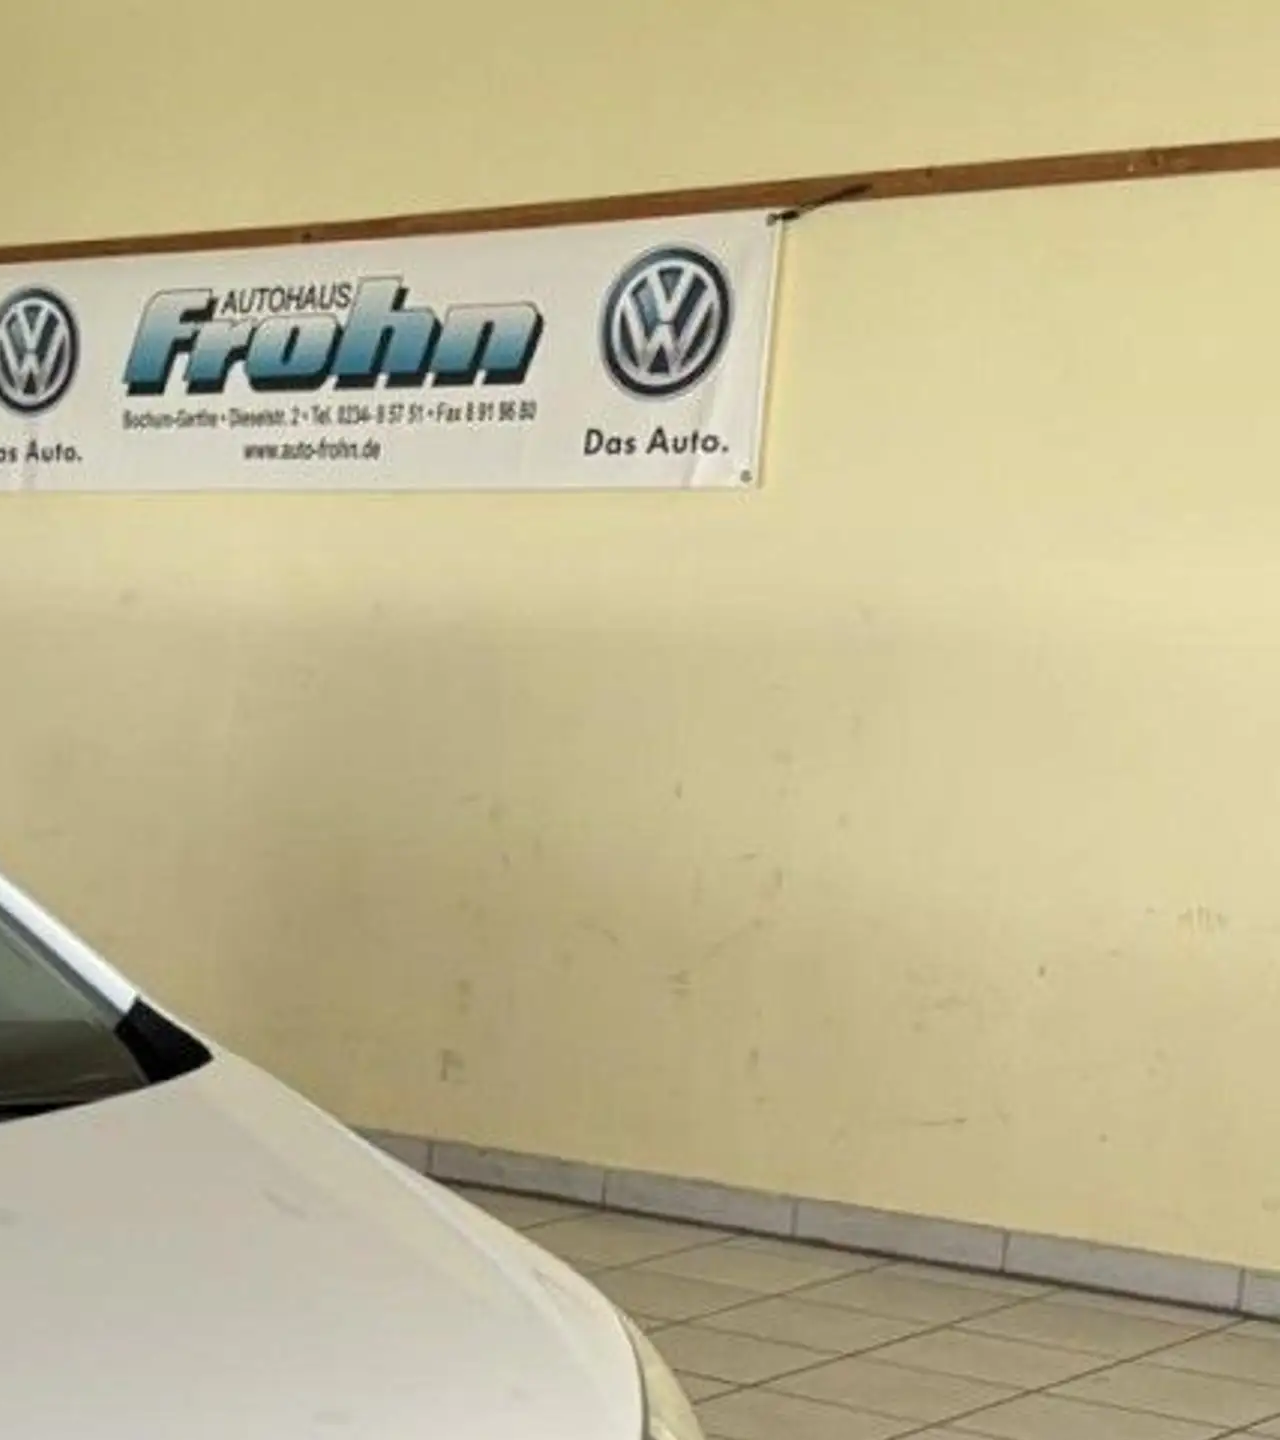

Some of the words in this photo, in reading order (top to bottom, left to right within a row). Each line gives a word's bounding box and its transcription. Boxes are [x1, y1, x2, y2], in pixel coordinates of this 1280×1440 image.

[220, 282, 354, 315] AUTOHAUS
[123, 275, 545, 396] Frohn
[25, 437, 83, 464] Auto.
[583, 427, 637, 457] Das
[645, 425, 730, 455] Auto.
